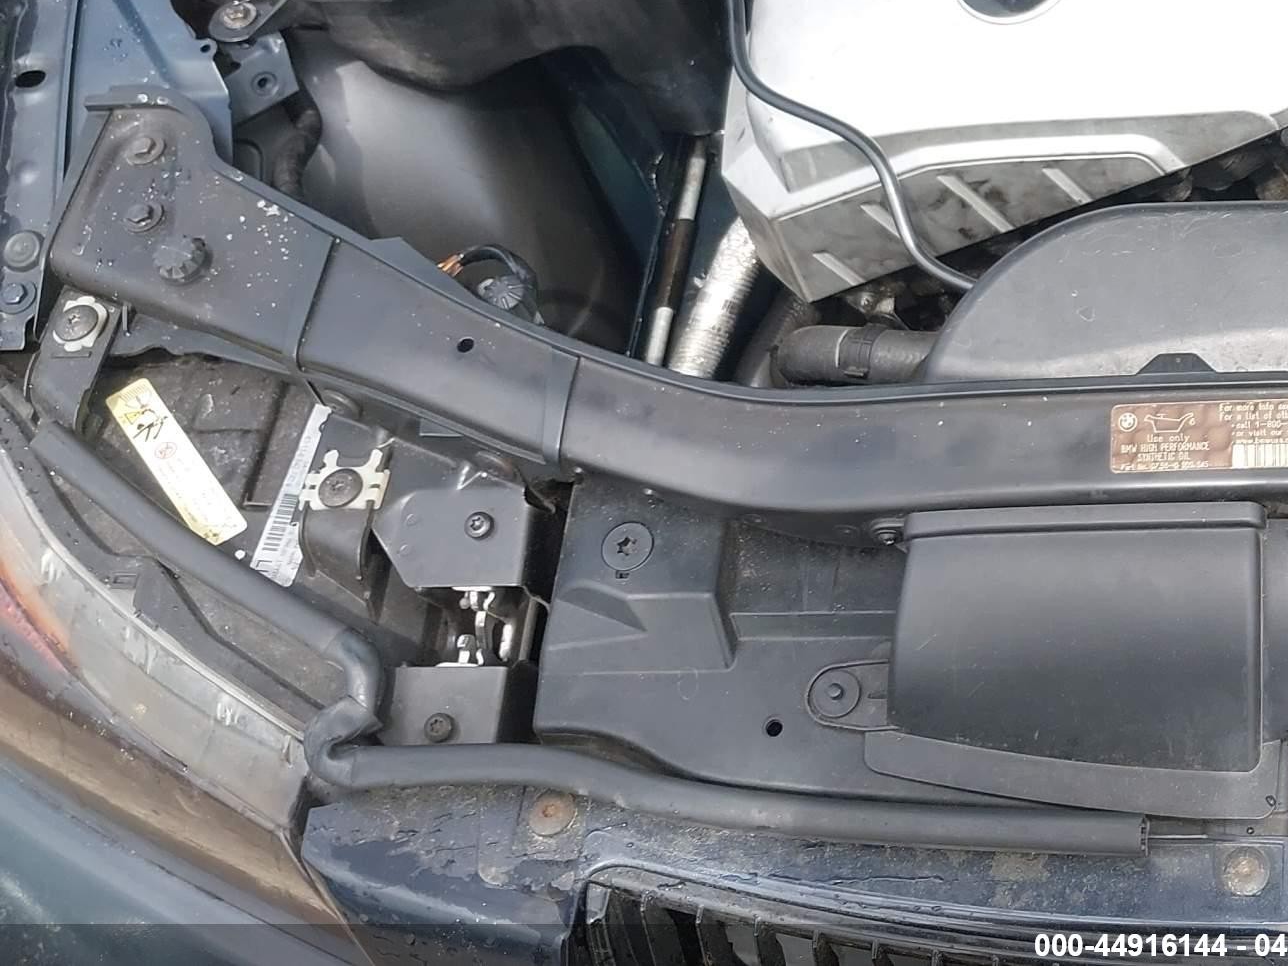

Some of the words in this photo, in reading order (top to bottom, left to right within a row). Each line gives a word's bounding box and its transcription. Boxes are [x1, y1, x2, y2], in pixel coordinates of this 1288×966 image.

[1219, 403, 1233, 412] For
[1236, 404, 1255, 412] more
[1146, 434, 1164, 443] Use
[1169, 432, 1191, 443] only
[1120, 444, 1138, 454] BMW
[1140, 443, 1158, 453] HIGH
[1160, 441, 1210, 452] PERFORMANCE
[1137, 452, 1176, 462] SYNTHETIC
